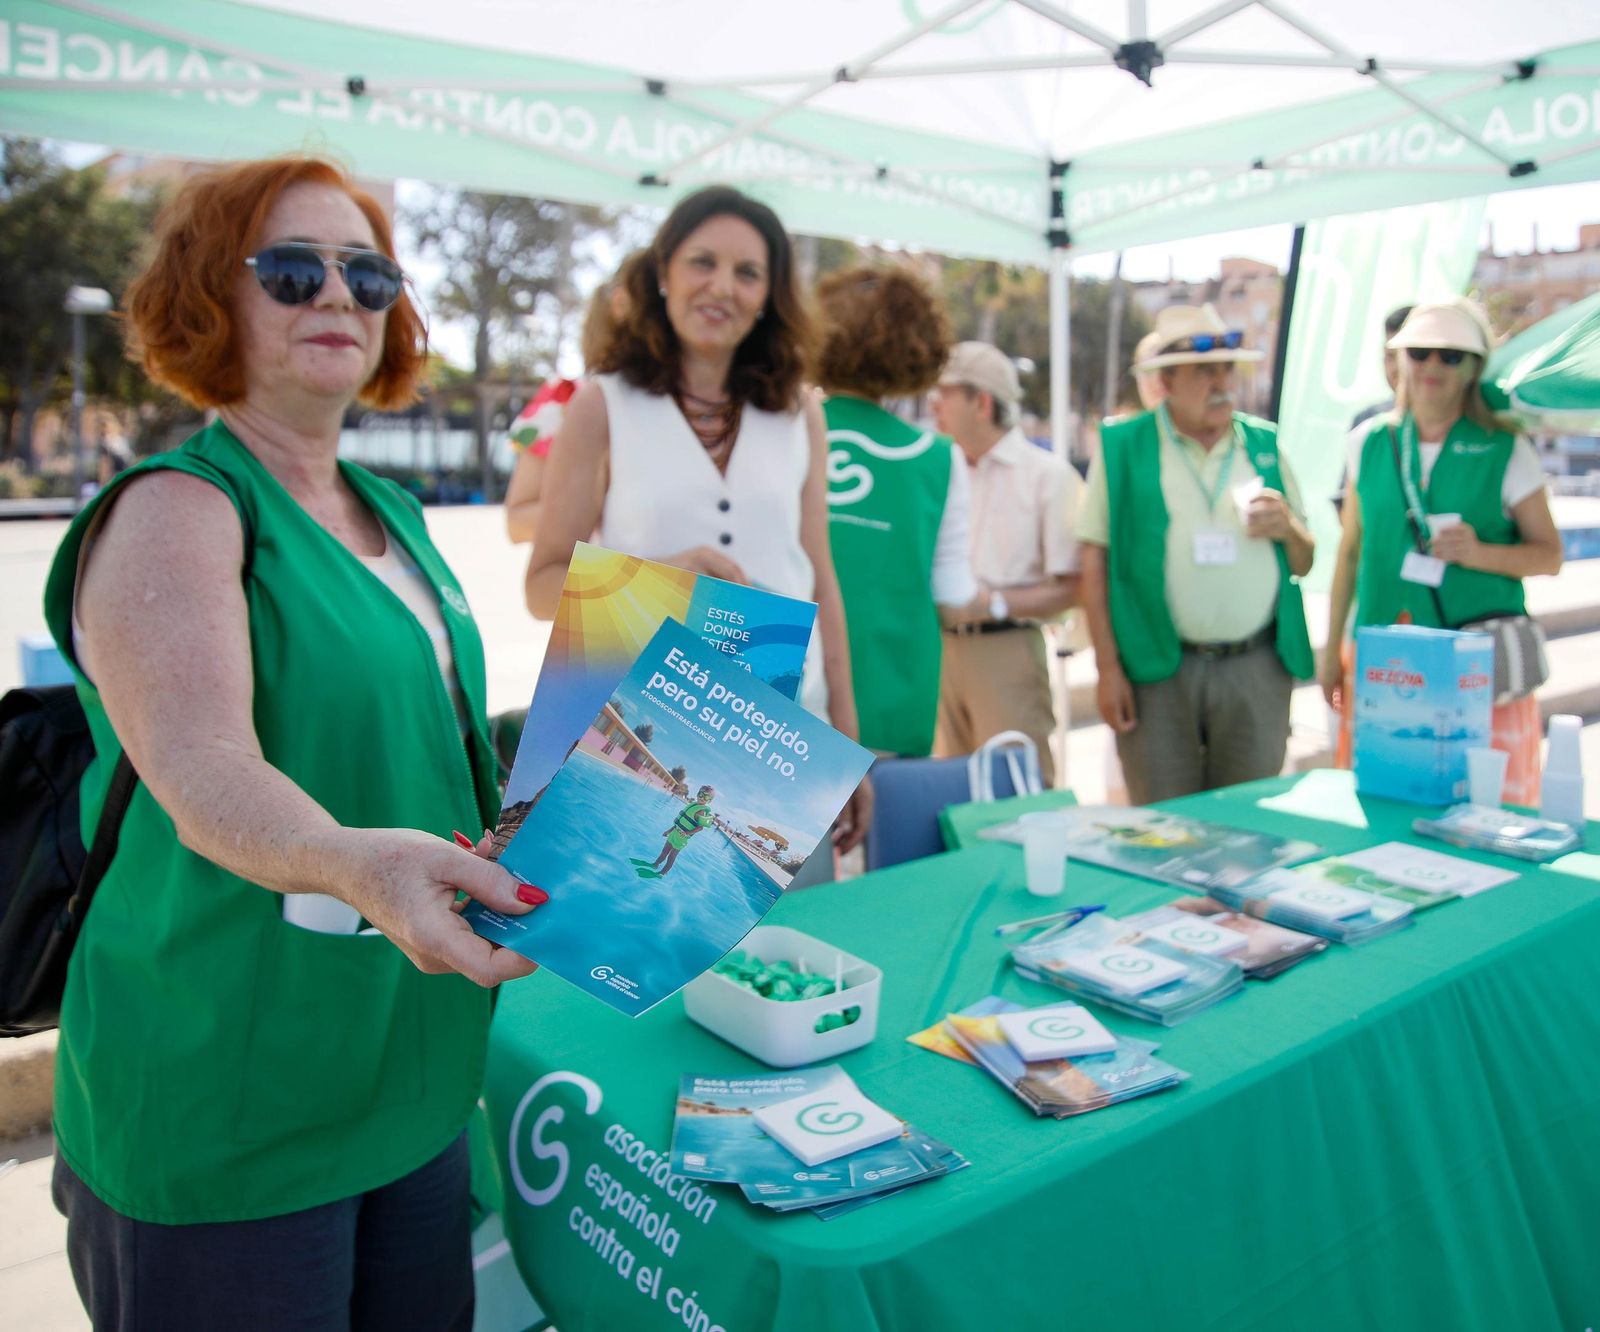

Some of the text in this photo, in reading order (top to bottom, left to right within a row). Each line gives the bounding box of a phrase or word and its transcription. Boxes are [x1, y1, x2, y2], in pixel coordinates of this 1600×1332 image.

[703, 621, 750, 642] DONDE
[707, 606, 745, 625] ESTÉS
[646, 671, 796, 781] pero su piel no.
[663, 647, 810, 762] Está protegido,
[584, 1163, 681, 1258] española
[603, 1123, 718, 1225] asociación
[569, 1206, 728, 1332] contra el cán
